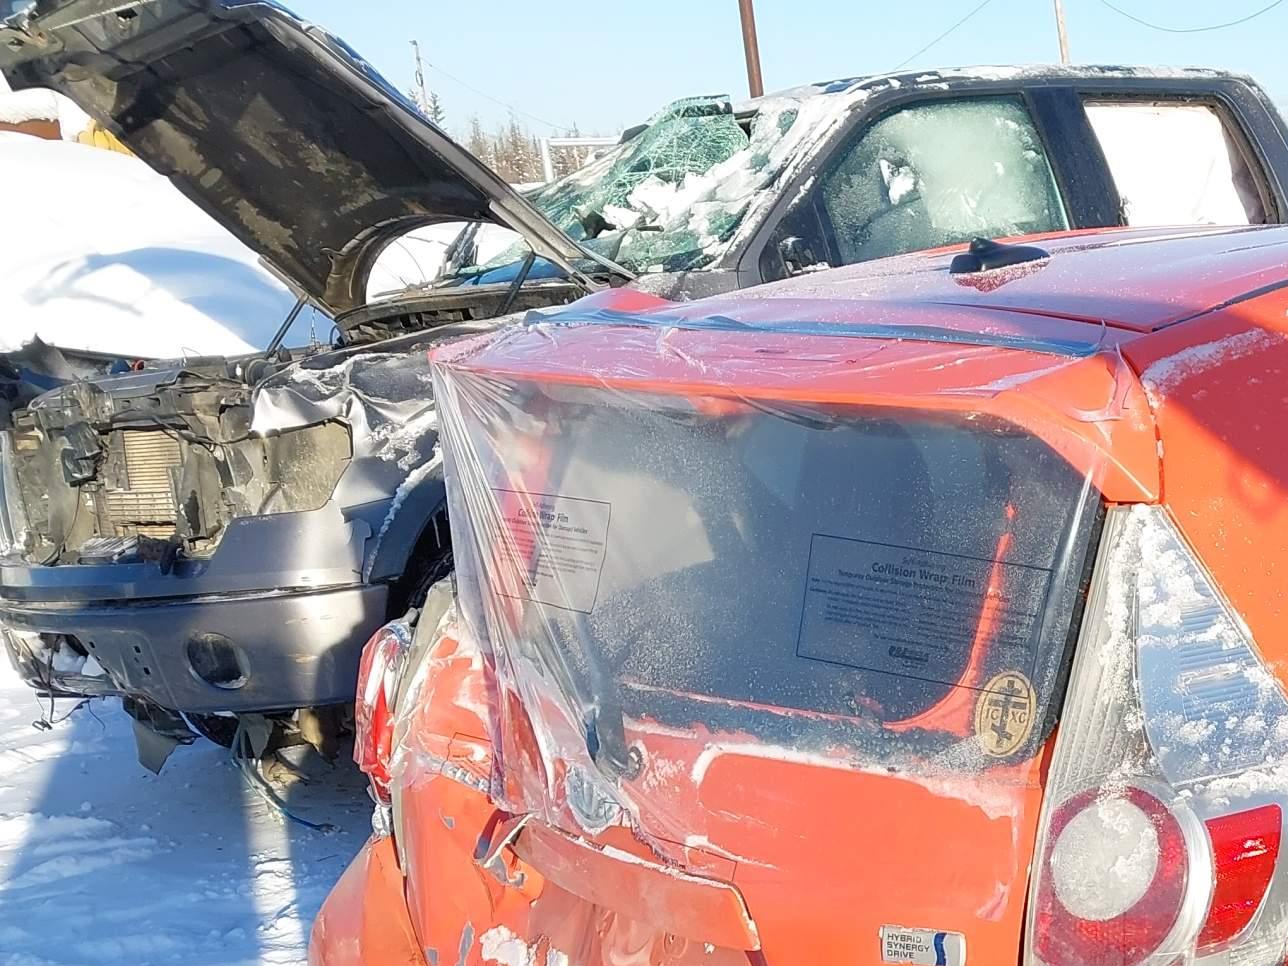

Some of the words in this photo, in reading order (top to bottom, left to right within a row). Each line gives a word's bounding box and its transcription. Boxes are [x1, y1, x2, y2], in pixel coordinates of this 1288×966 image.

[871, 562, 917, 578] Collision
[919, 567, 948, 584] Wrap
[951, 574, 976, 588] Film
[887, 932, 922, 944] HYBRID
[886, 941, 930, 953] SYNERGY
[886, 949, 915, 959] DRIVE
